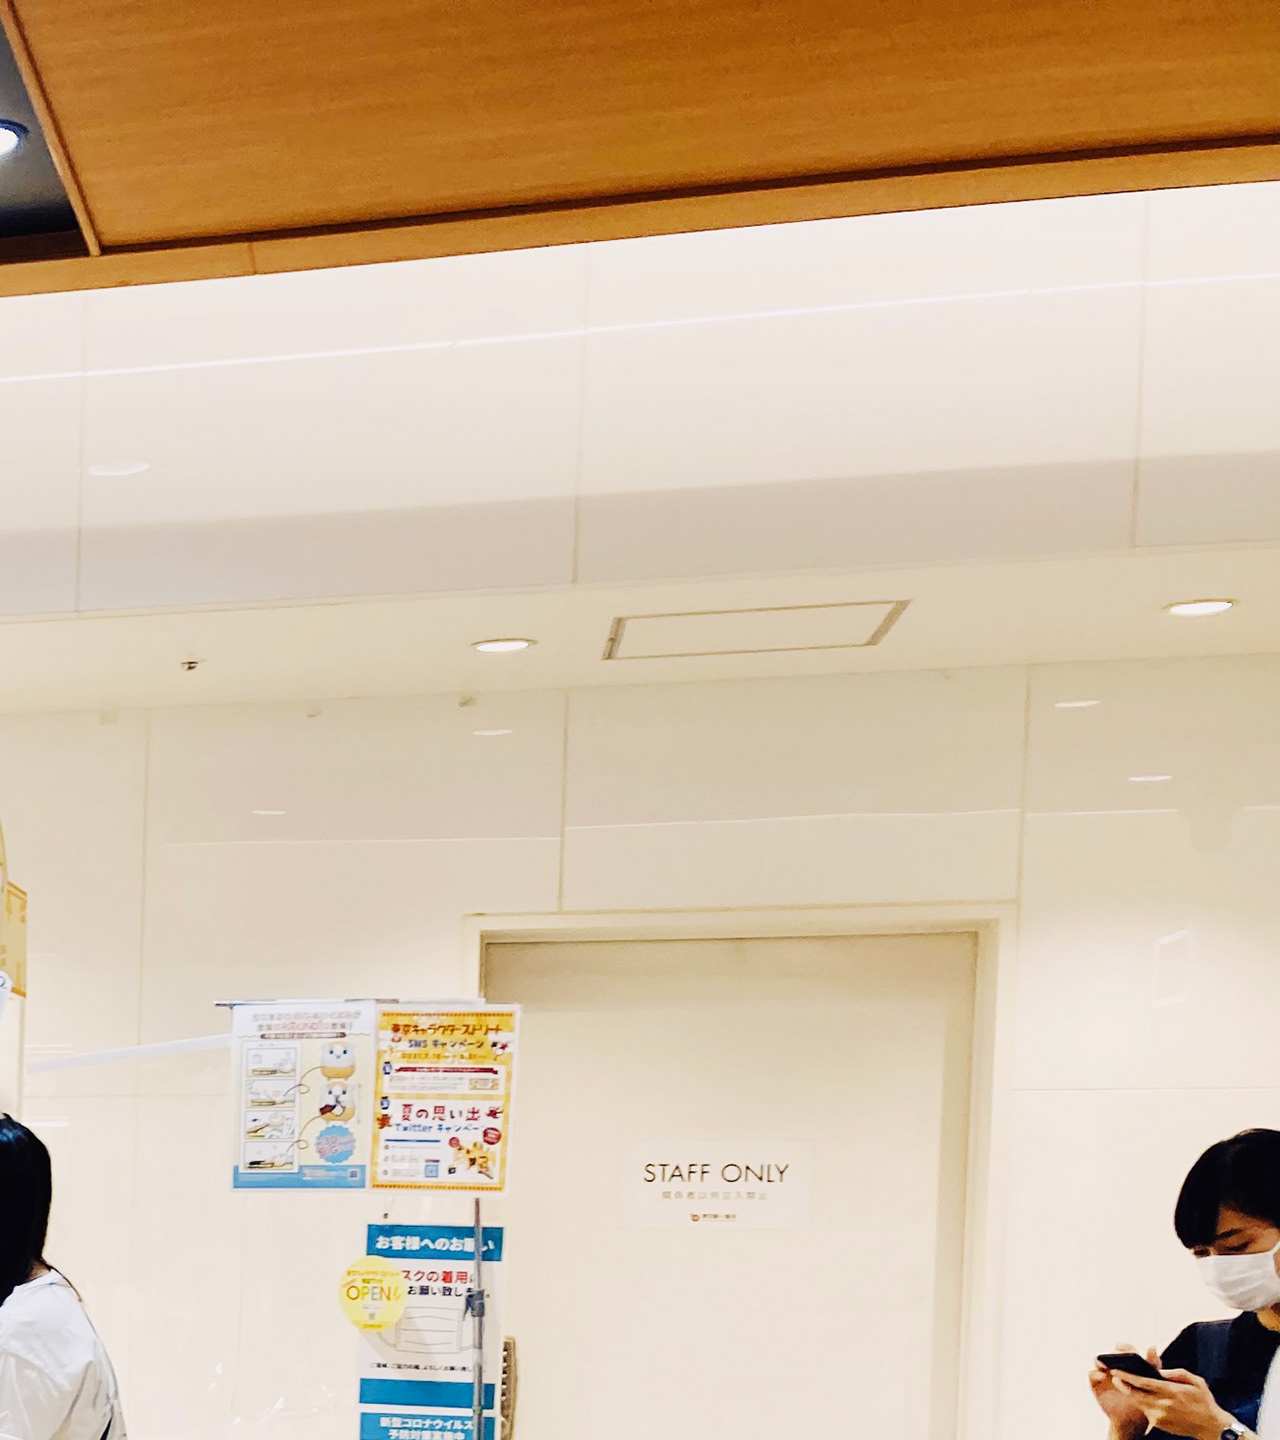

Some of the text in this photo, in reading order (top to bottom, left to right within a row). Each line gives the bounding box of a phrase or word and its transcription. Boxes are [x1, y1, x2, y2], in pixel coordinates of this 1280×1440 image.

[401, 1103, 481, 1122] 夏の思い出
[395, 1123, 432, 1133] Twitter
[643, 1163, 790, 1183] STAFF ONLY
[376, 1235, 495, 1253] お客様へのお願い
[380, 1416, 474, 1431] 新型コロナウイルス
